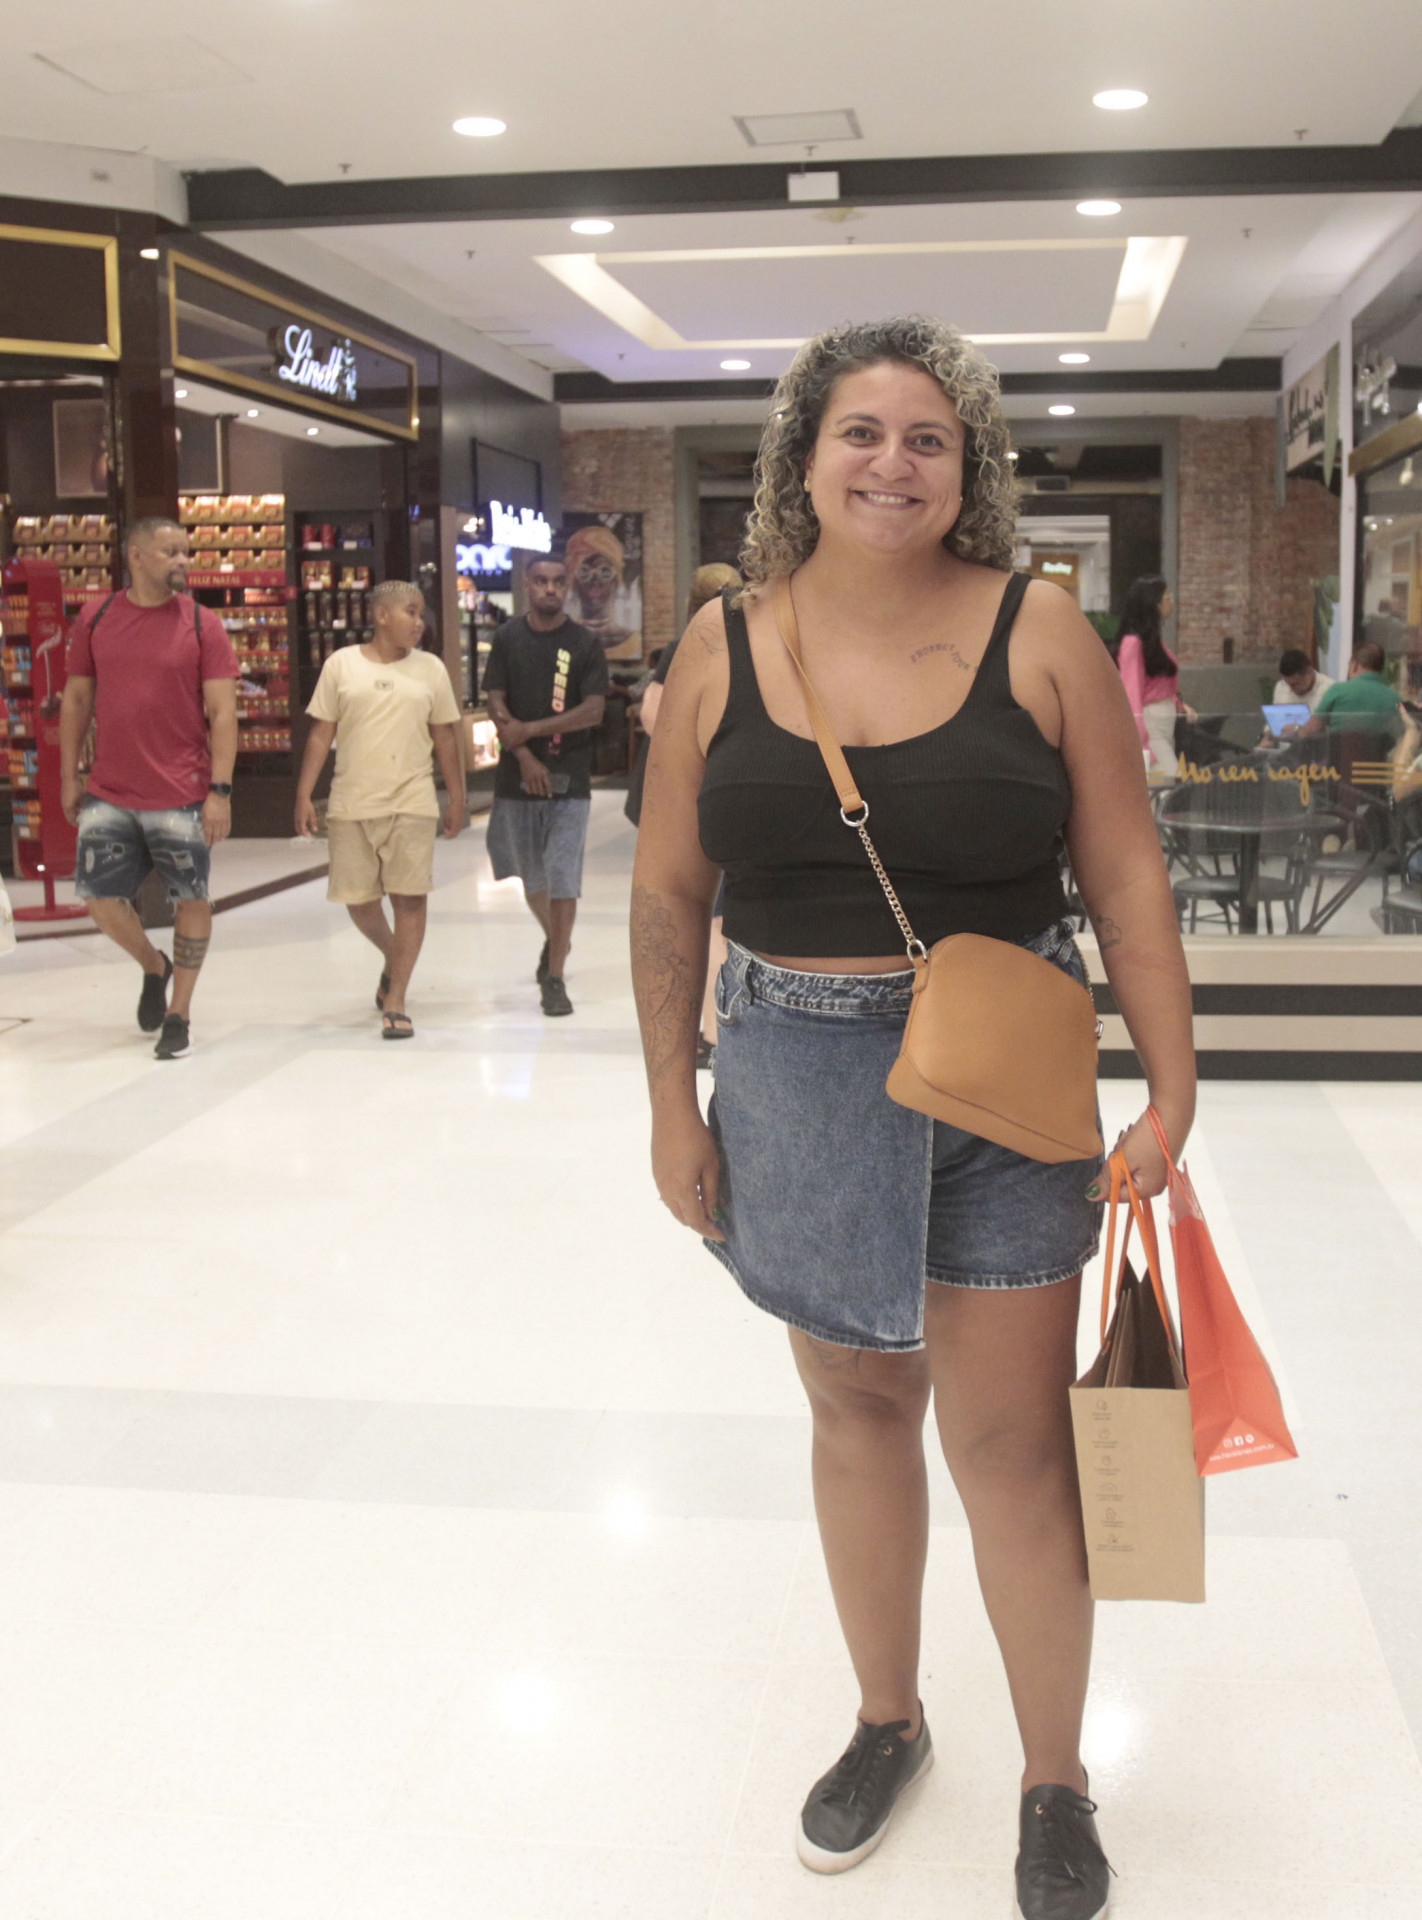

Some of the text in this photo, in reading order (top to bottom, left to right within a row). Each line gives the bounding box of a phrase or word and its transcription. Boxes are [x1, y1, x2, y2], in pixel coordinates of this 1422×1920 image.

[279, 325, 343, 394] Lindt
[212, 575, 241, 585] NATAL
[551, 648, 571, 713] SPEED
